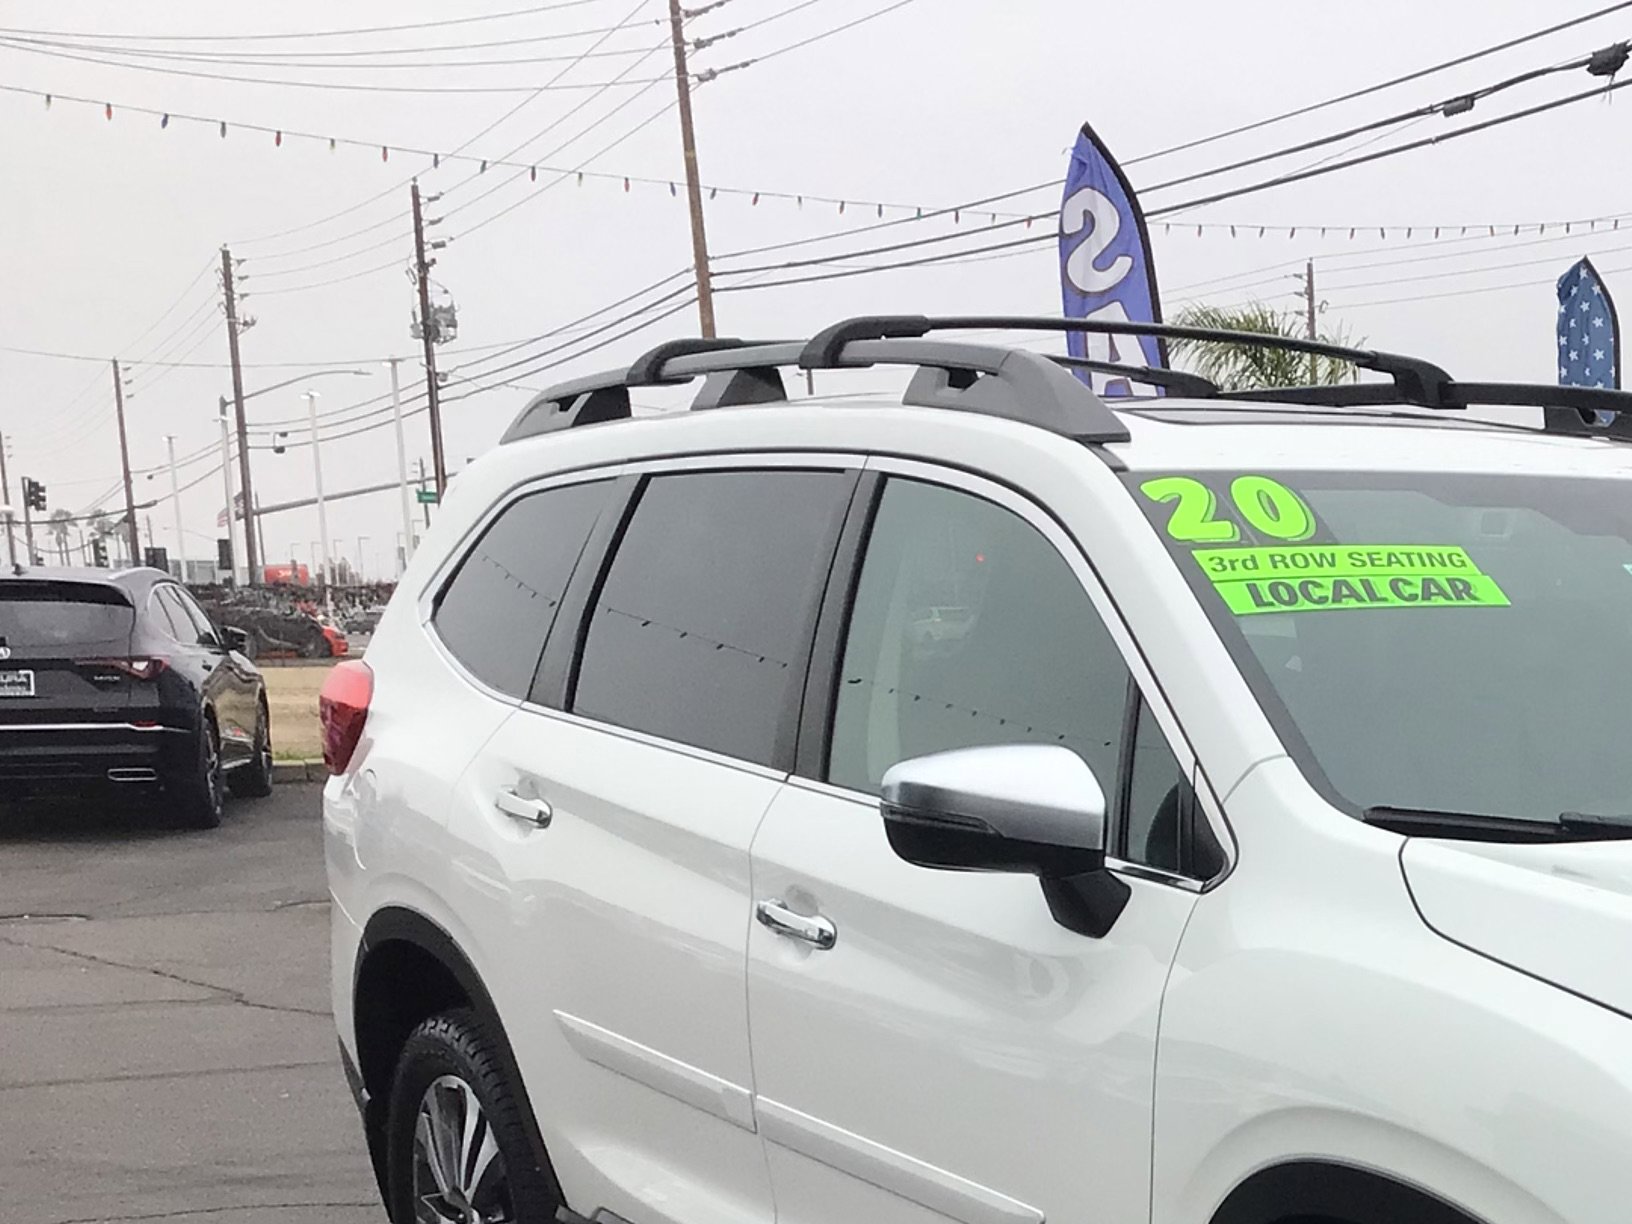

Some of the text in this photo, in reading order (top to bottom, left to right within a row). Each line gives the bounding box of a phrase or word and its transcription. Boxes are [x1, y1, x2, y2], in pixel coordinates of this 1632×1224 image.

[1139, 474, 1317, 543] 20
[1208, 552, 1468, 572] 3rd ROW SEATING
[1245, 577, 1481, 608] LOCAL CAR
